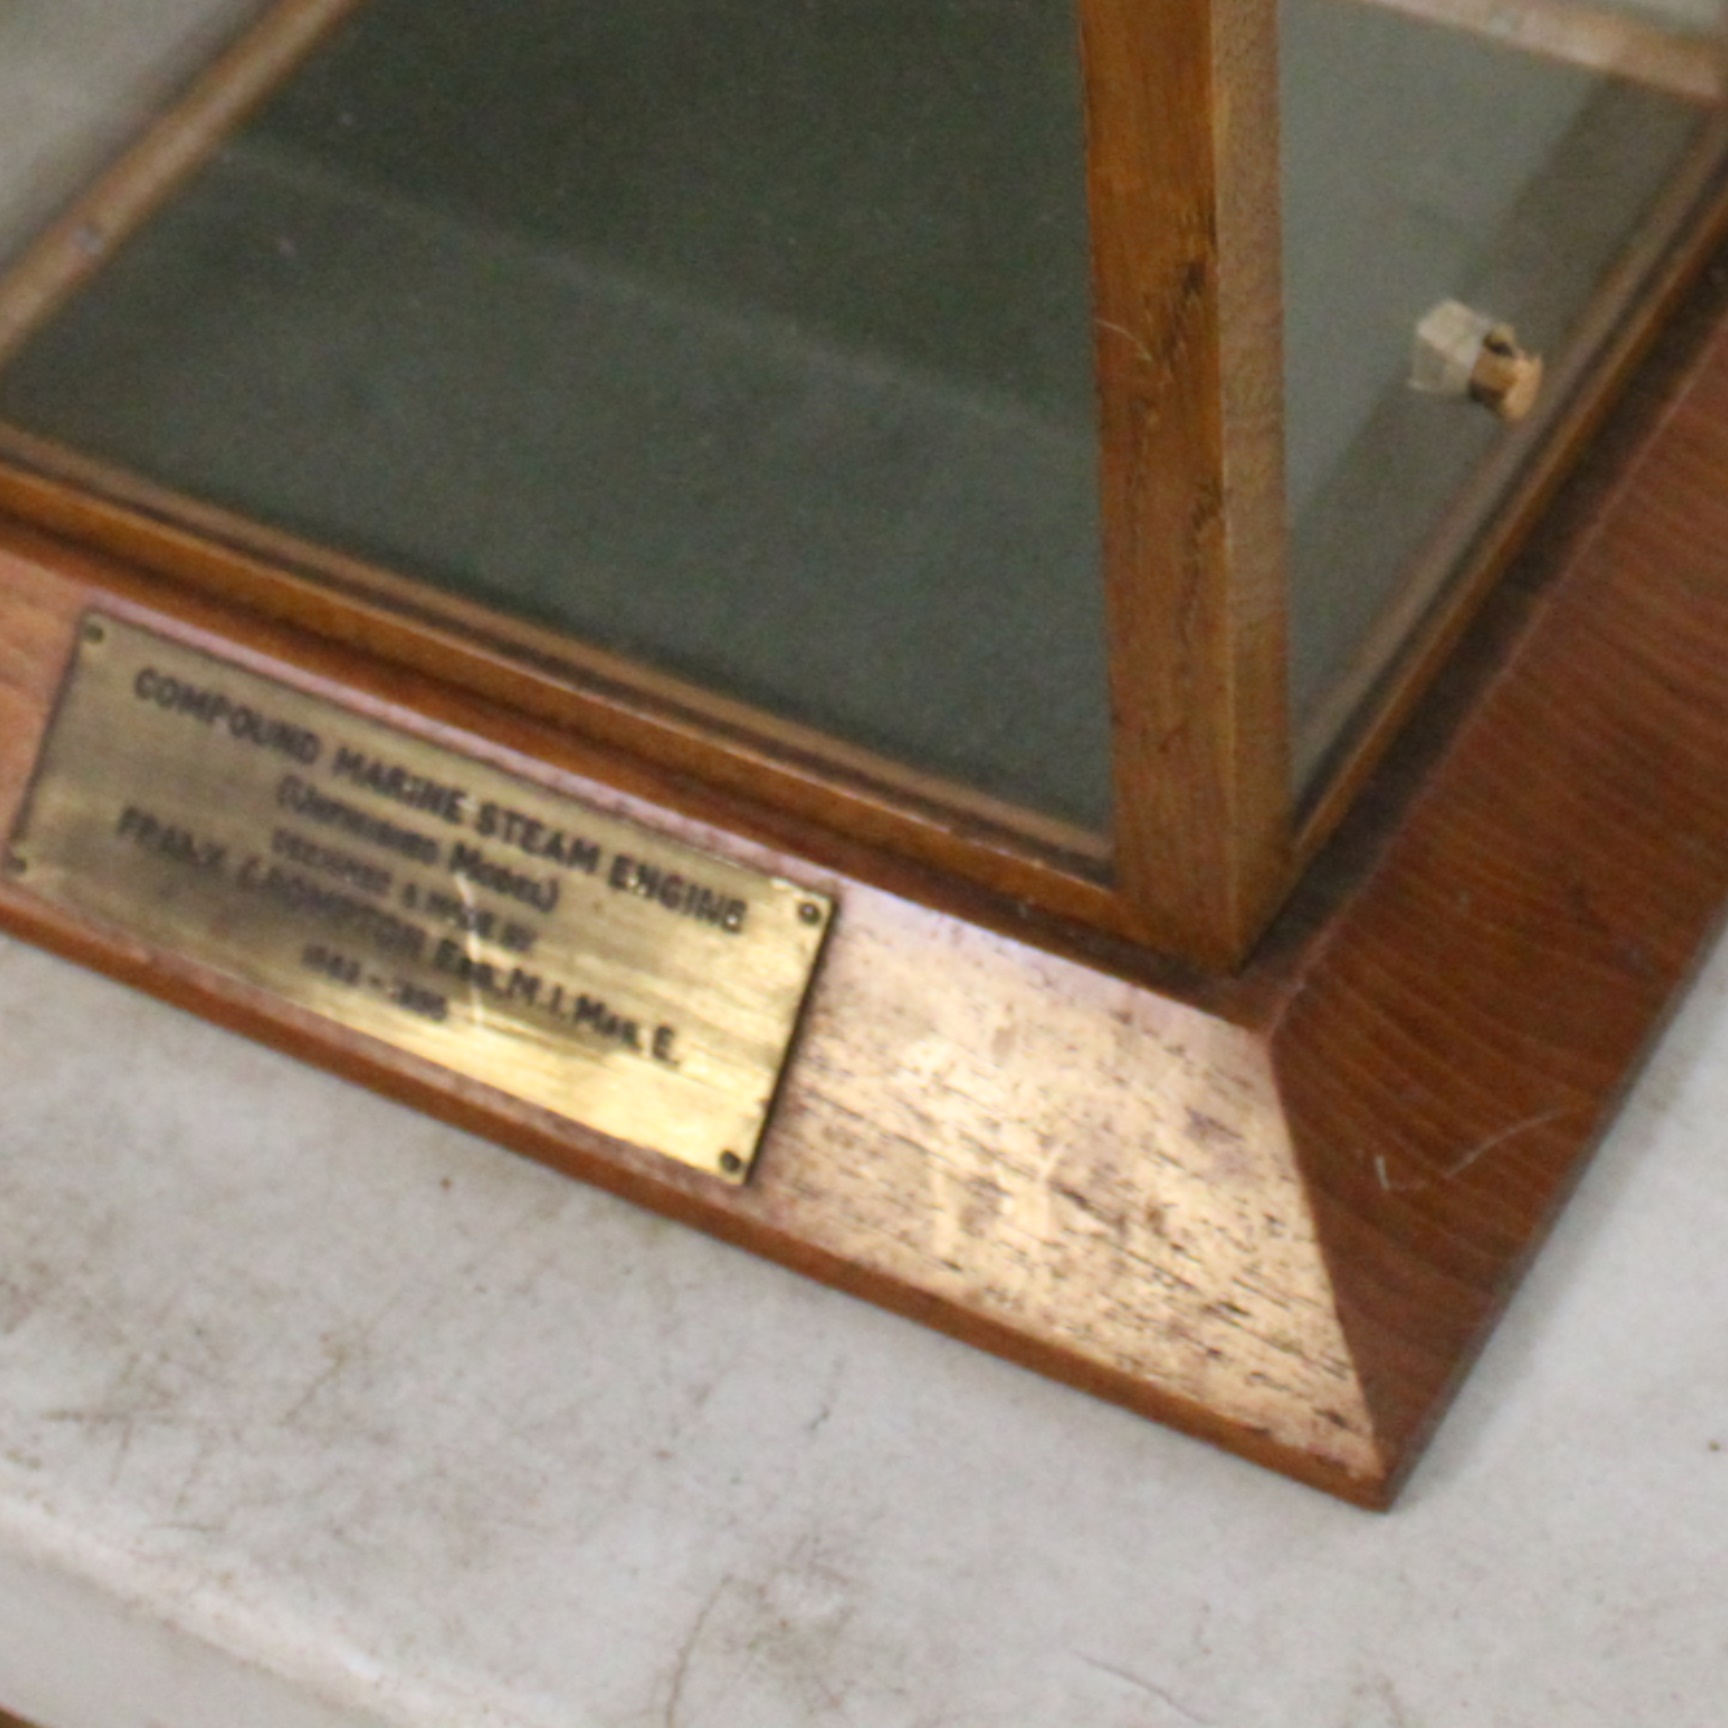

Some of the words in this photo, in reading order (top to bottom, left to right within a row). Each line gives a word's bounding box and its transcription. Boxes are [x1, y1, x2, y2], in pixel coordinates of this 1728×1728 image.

[134, 668, 320, 762] COMPOUND
[334, 747, 466, 821] MARINE
[475, 802, 599, 872] STEAM
[609, 855, 747, 932] ENGINE
